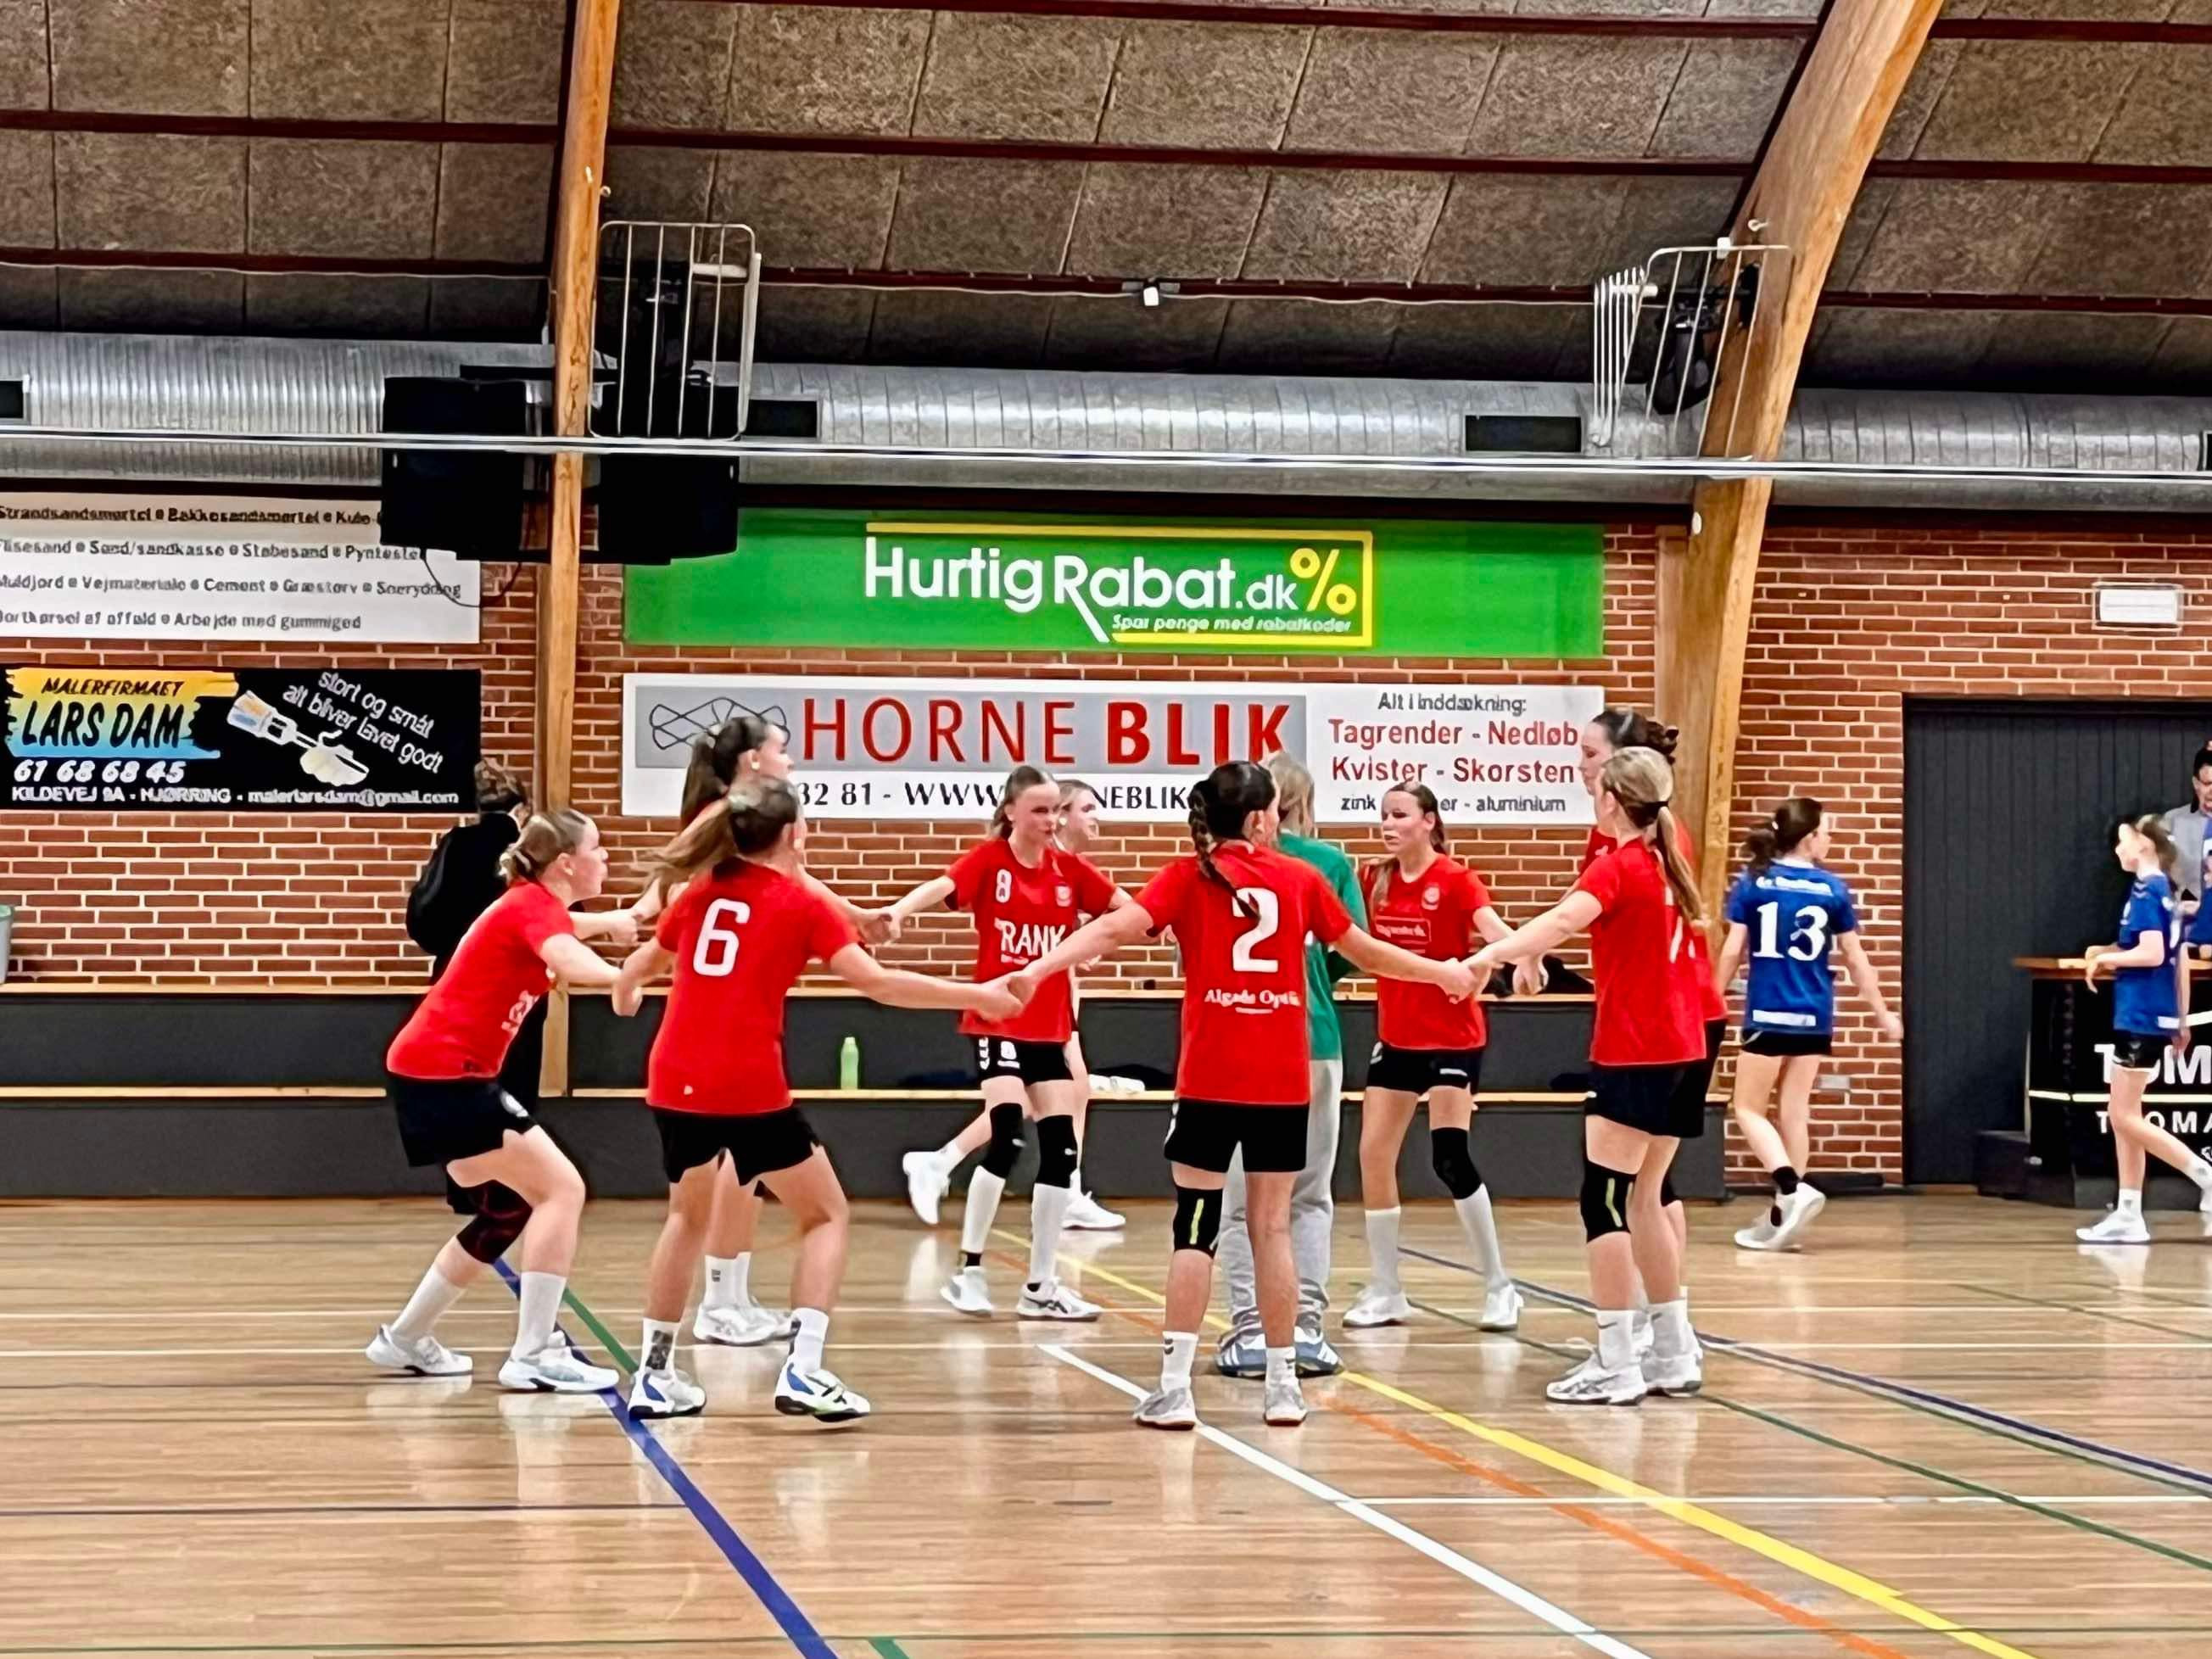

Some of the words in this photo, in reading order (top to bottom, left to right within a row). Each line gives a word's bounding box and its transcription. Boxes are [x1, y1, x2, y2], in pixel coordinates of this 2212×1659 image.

[204, 578, 265, 593] Cement
[107, 612, 156, 626] affald
[242, 614, 276, 628] med
[1113, 614, 1148, 631] Spar
[1153, 616, 1209, 634] penge
[1214, 615, 1254, 631] med
[41, 678, 184, 697] MALERFIRMAET
[1377, 691, 1404, 711] Alt
[361, 693, 387, 720] og
[22, 701, 104, 747] LARS
[109, 702, 185, 748] DAM
[282, 684, 309, 708] alt
[307, 692, 357, 730] bliver
[397, 742, 444, 774] godt
[802, 696, 1076, 765] HORNE
[1107, 701, 1292, 767] BLIK
[1328, 718, 1463, 750] Tagrender
[1488, 720, 1578, 746] Nedløb
[57, 760, 96, 783] 68
[102, 760, 140, 783] 68
[146, 760, 187, 784] 45
[1332, 756, 1427, 782] Kvister
[1453, 757, 1575, 784] Skorsten
[12, 786, 98, 802] KILDEVEJ
[841, 782, 870, 806] 81
[904, 782, 1003, 807] WWW
[1092, 786, 1188, 810] NEBLIK
[1340, 796, 1377, 811] zink
[1476, 796, 1566, 812] aluminium
[995, 869, 1012, 903] 8
[693, 897, 751, 976] 6
[1232, 887, 1279, 973] 2
[1752, 901, 1829, 961] 13
[2094, 1043, 2212, 1085] TM
